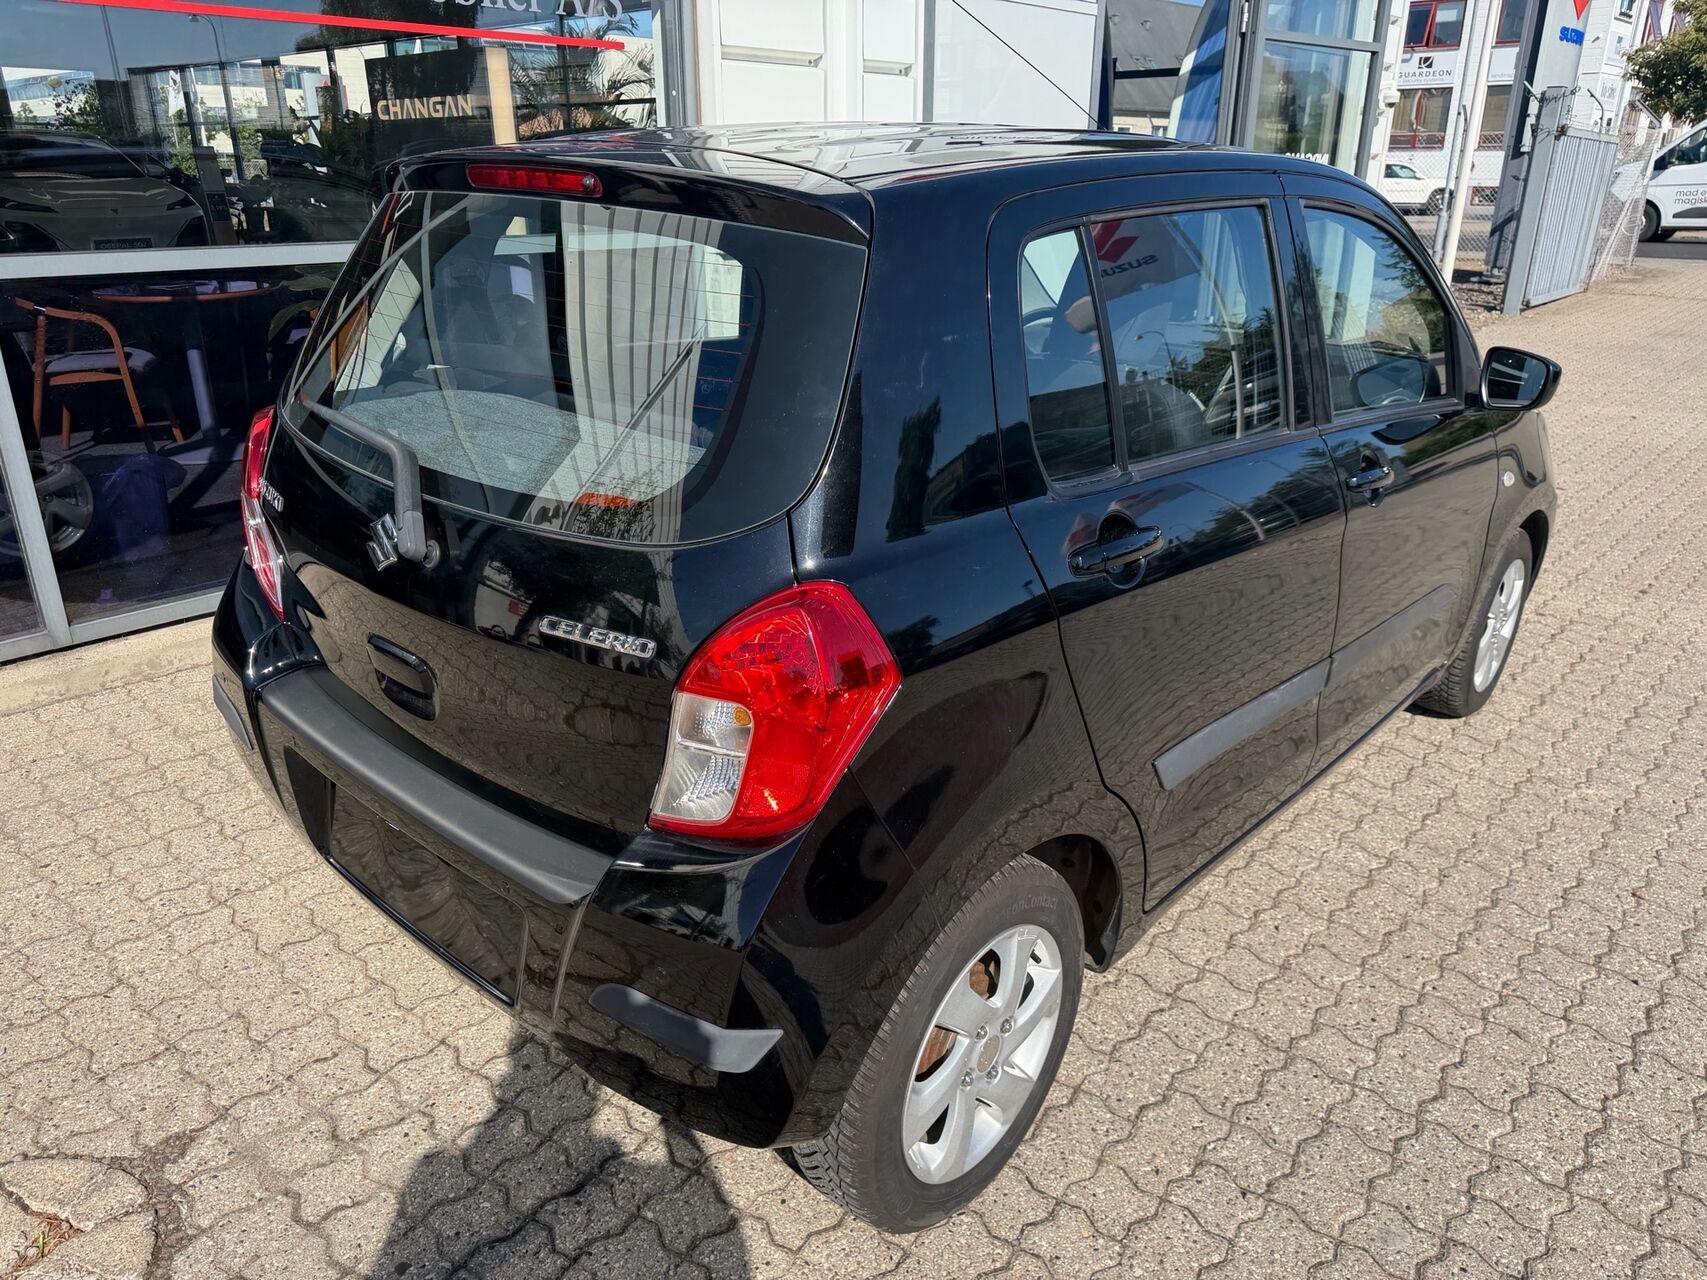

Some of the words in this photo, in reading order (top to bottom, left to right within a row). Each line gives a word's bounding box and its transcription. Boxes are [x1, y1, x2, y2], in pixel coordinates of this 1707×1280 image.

[1398, 69, 1452, 79] GUARDEON
[377, 94, 473, 120] CHANGAN
[1675, 189, 1699, 197] mad
[539, 615, 657, 659] CELERIO
